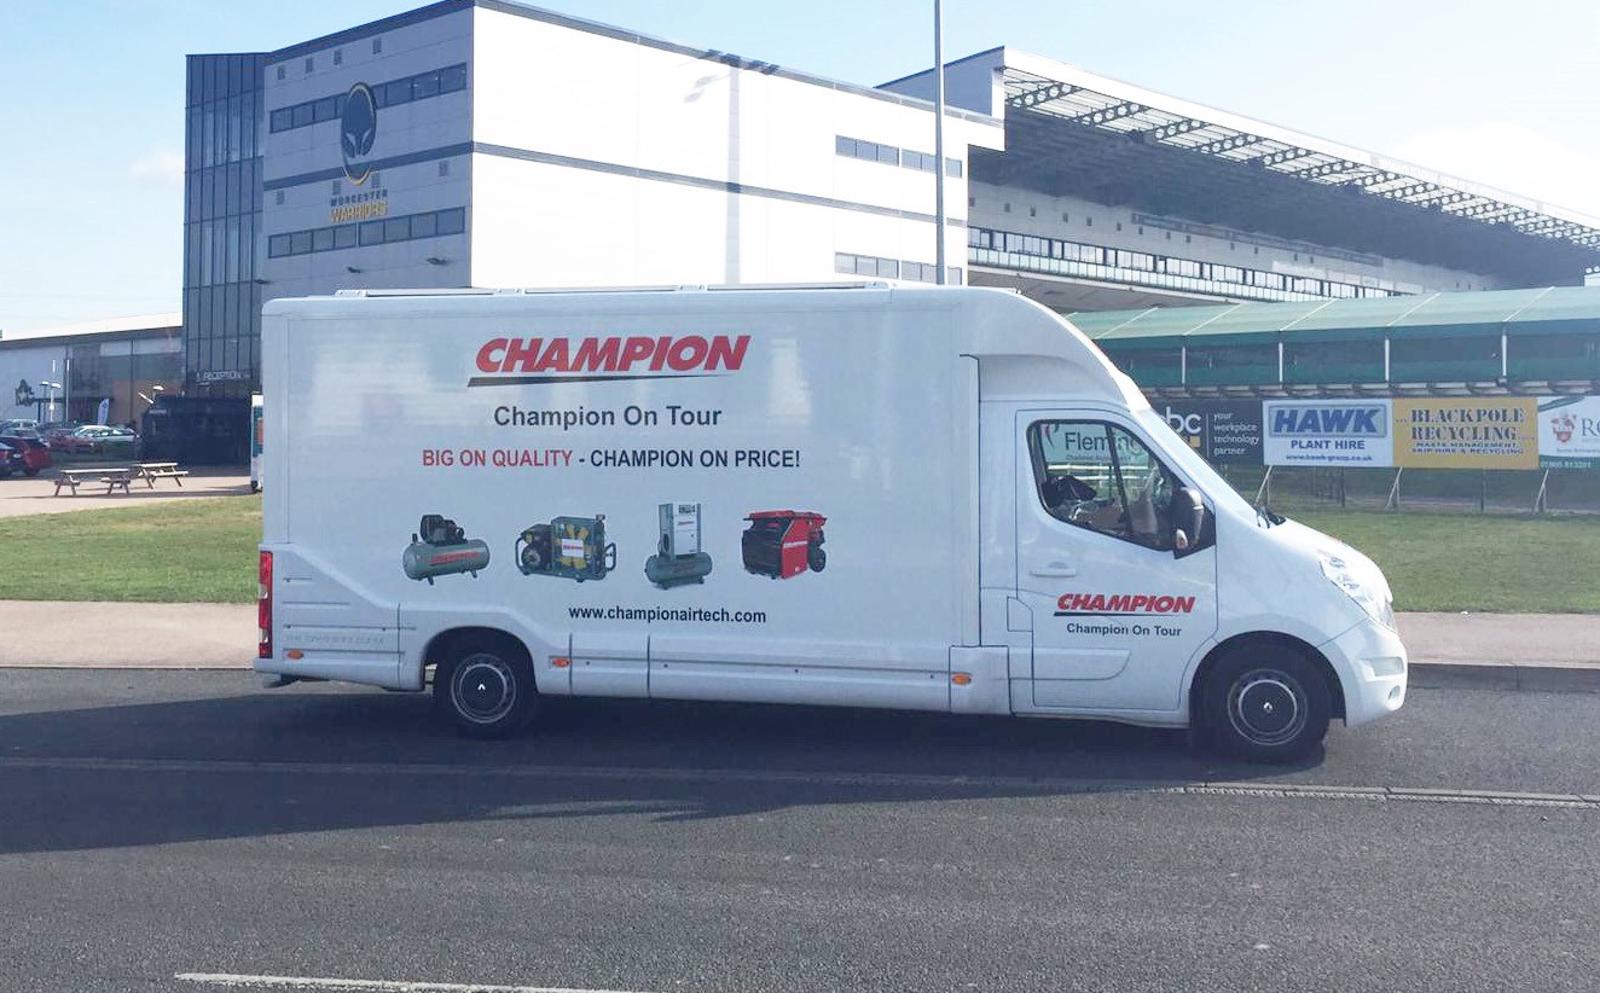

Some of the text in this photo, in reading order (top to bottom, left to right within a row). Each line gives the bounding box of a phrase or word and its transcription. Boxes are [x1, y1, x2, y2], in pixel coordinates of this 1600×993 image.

[330, 189, 388, 207] WORCESTER
[329, 200, 388, 224] WARRIORS
[475, 335, 751, 373] CHAMPION
[494, 405, 722, 430] Champion On Tour
[1160, 406, 1202, 434] bc
[1214, 412, 1234, 421] your
[1273, 409, 1381, 433] HAWK
[1411, 408, 1525, 423] BLACKPOLE
[1213, 423, 1257, 432] workplace
[1411, 426, 1517, 440] RECYCLING
[1213, 434, 1260, 446] technology
[1291, 440, 1366, 450] PLANT HIRE
[422, 449, 454, 467] BIG
[460, 449, 486, 467] ON
[492, 449, 572, 468] QUALITY
[590, 449, 693, 468] CHAMPION
[700, 449, 728, 468] ON
[735, 449, 801, 468] PRICE!
[1213, 447, 1245, 456] partner
[1057, 593, 1196, 613] CHAMPION
[568, 606, 767, 623] www.championairtech.com
[1067, 623, 1182, 637] Champion On Tour
